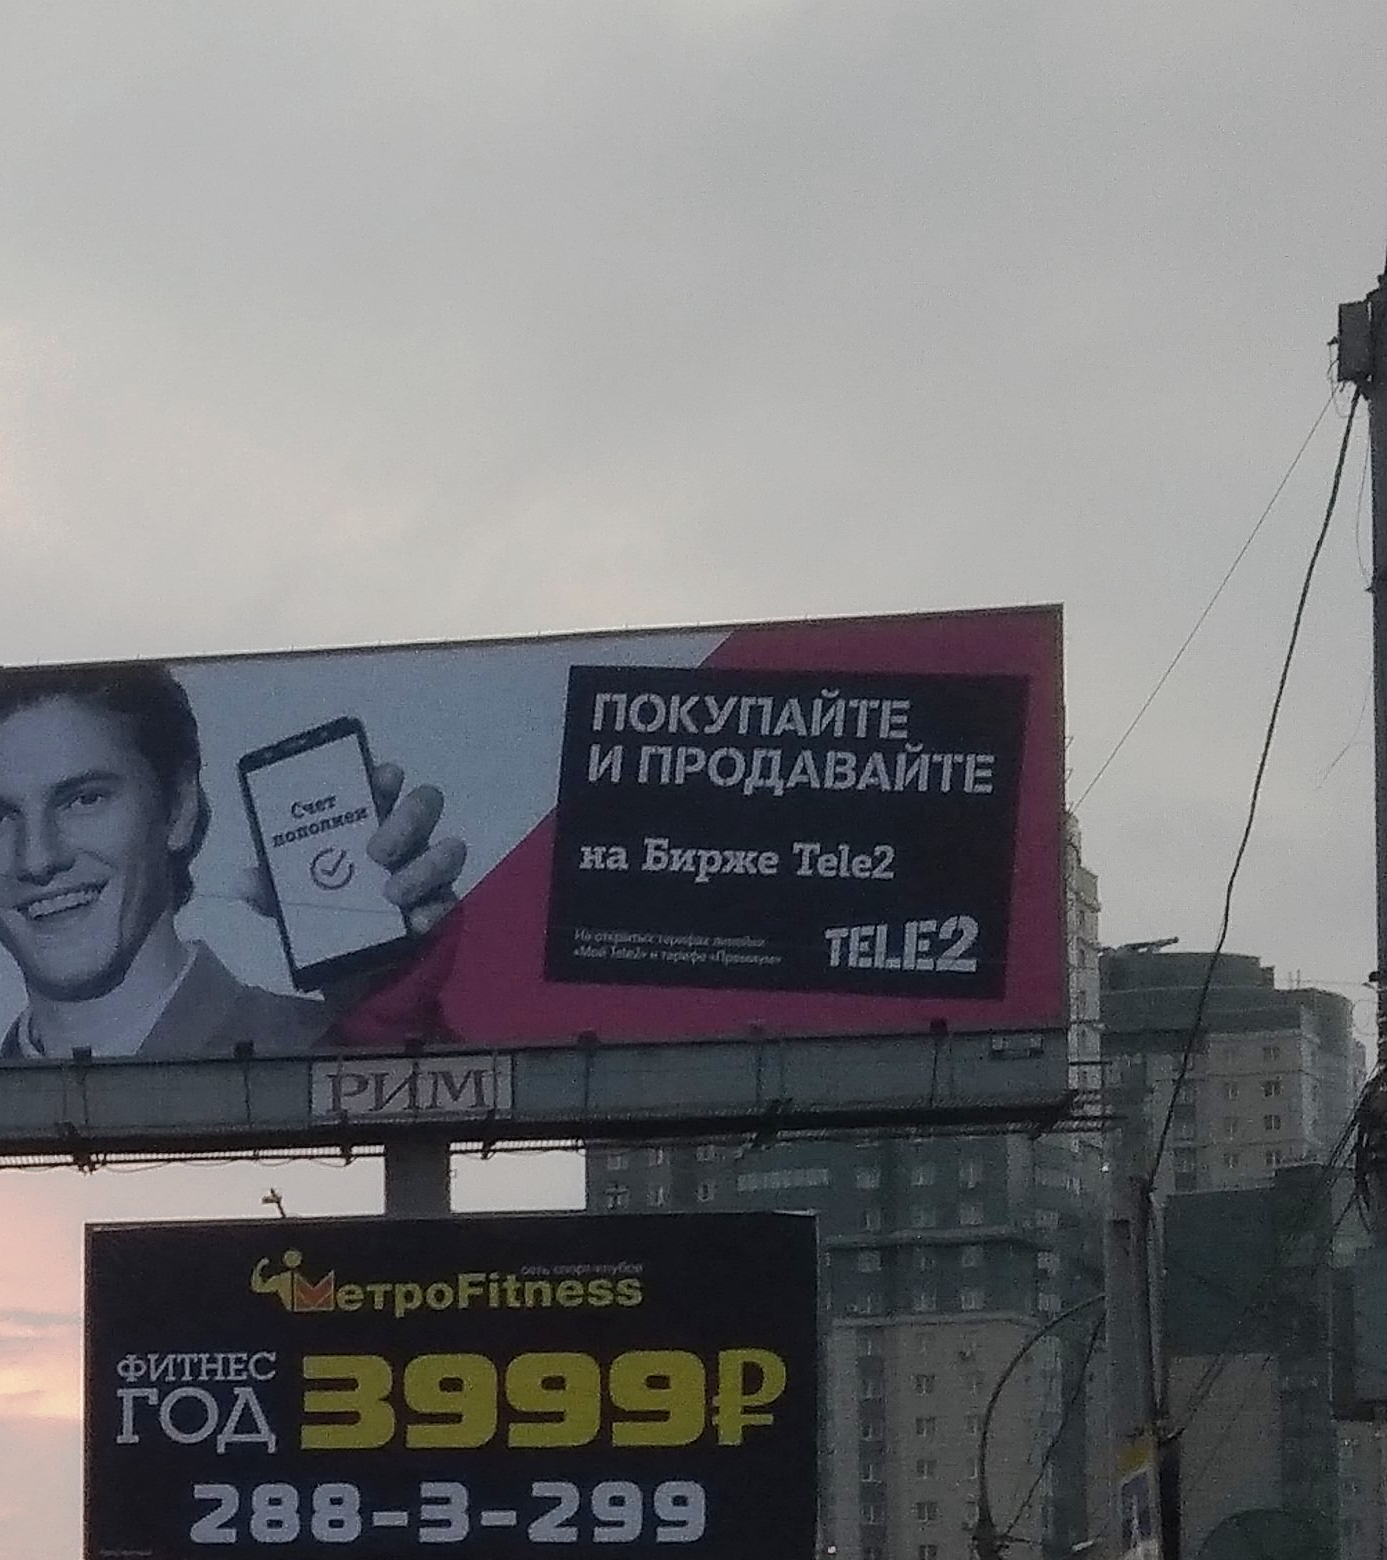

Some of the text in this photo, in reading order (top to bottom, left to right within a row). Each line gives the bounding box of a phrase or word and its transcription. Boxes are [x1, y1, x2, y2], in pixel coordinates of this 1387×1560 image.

[591, 687, 911, 740] ПОКУПАЙТЕ
[587, 741, 996, 796] И ПРОДАВАЙТЕ
[272, 806, 368, 848] пополнен
[578, 837, 896, 883] на Бирже Tele2
[824, 913, 980, 973] TELE2
[326, 1066, 491, 1113] РИМ
[115, 1350, 278, 1384] ФИТНЕС
[114, 1385, 278, 1455] ГОД
[189, 1479, 707, 1544] 288-3-299
